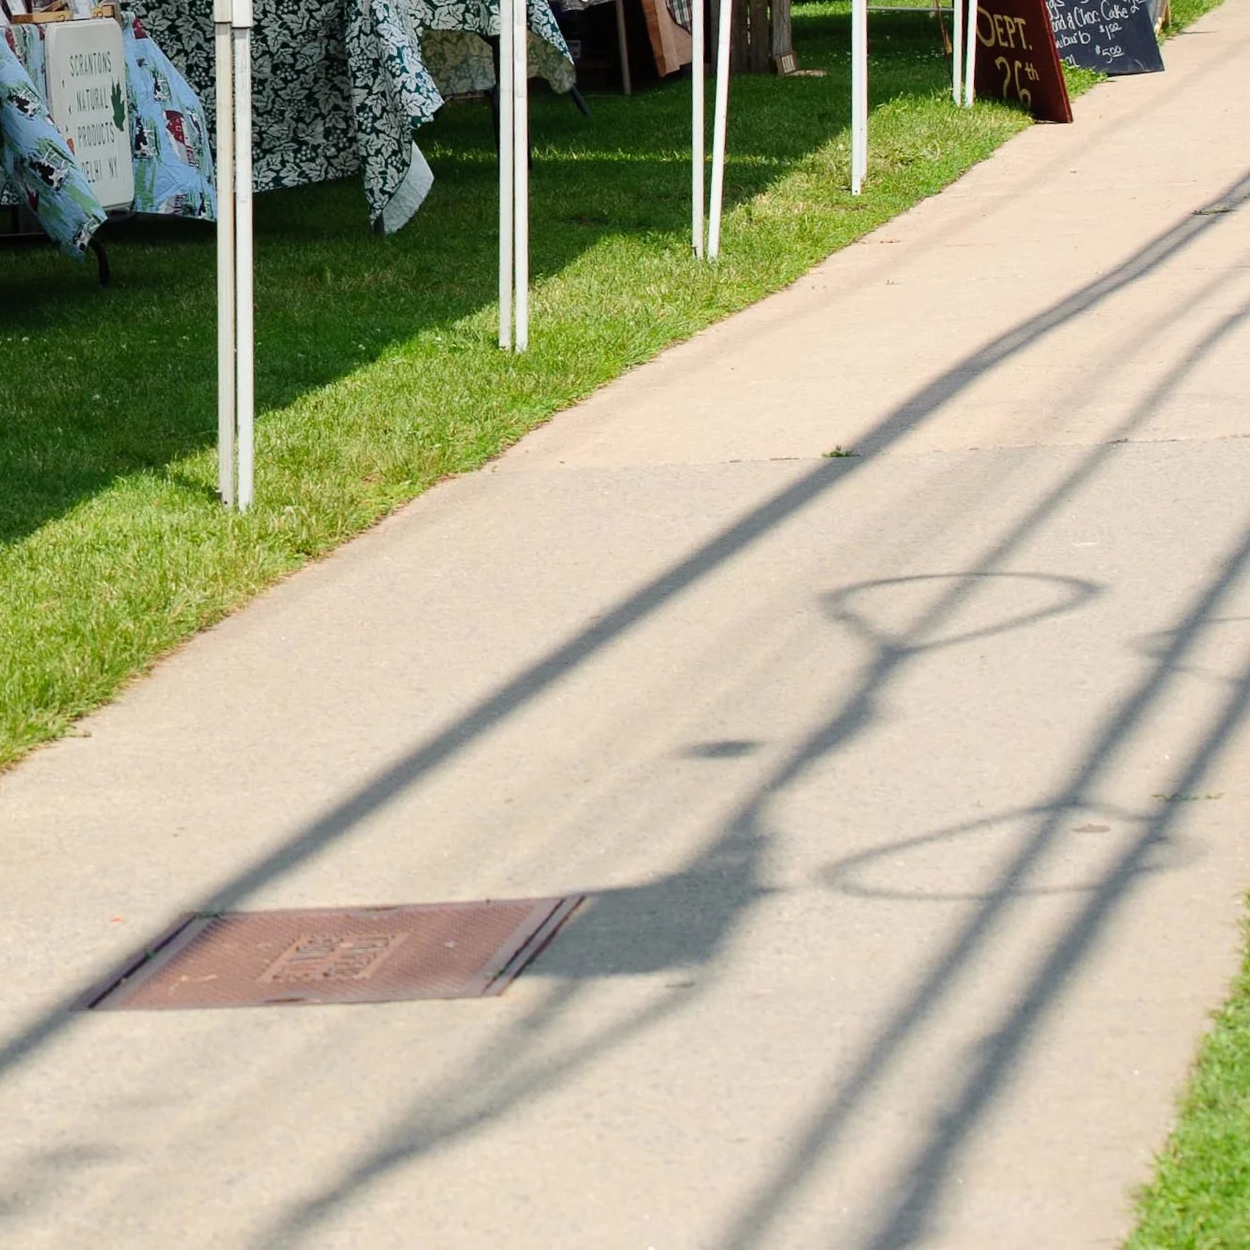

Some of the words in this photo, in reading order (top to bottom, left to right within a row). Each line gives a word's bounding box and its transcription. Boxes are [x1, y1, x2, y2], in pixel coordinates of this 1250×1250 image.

[1100, 0, 1129, 21] Cake
[69, 50, 112, 78] SCRANTONS
[76, 87, 110, 111] NATURAL
[77, 121, 115, 148] PRODUCTS
